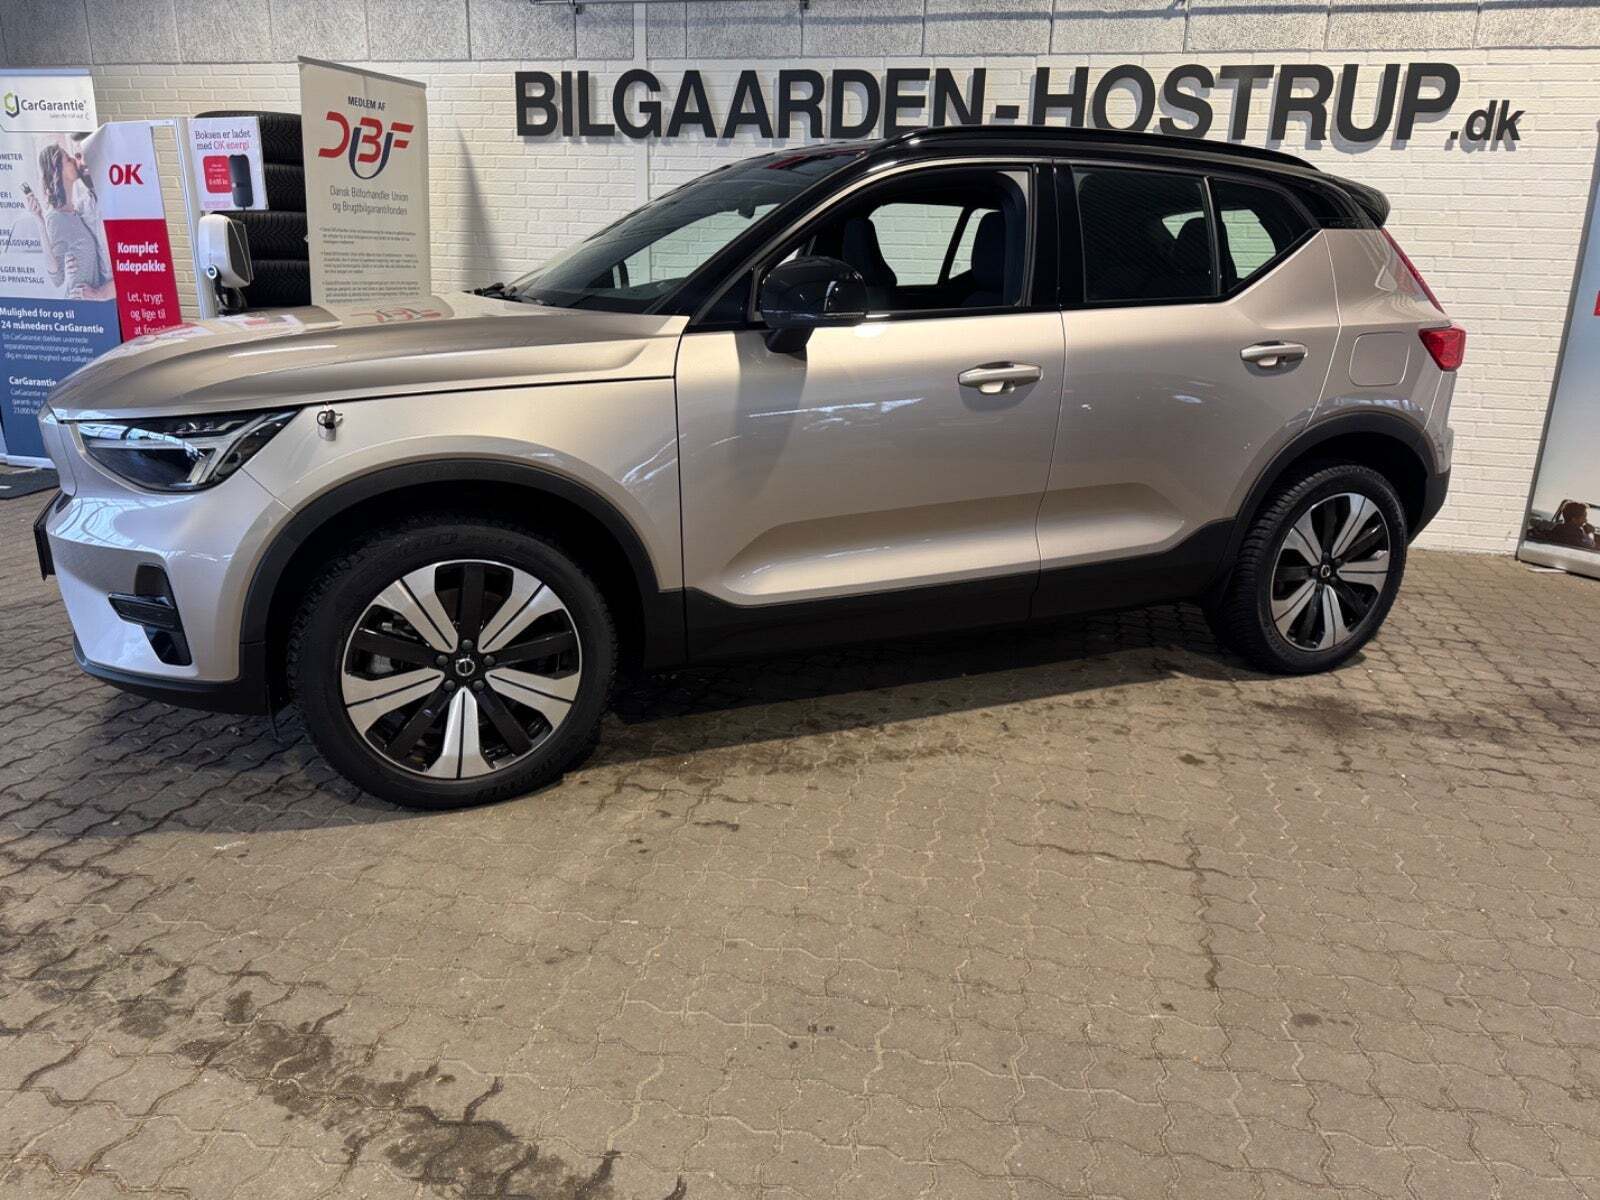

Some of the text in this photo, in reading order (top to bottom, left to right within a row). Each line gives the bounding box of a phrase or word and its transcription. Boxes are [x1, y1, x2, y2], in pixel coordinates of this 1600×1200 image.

[347, 96, 386, 111] MEDLEM AF
[223, 130, 230, 139] er
[196, 141, 212, 150] med
[109, 164, 144, 186] OK
[330, 185, 350, 197] Dansk
[117, 241, 159, 257] Komplet
[116, 259, 166, 275] ladepakke
[143, 293, 163, 305] trygt
[0, 307, 75, 320] Mulighed for op til
[130, 308, 167, 322] og lige til
[1, 320, 104, 334] 24 måneders CarGarantie
[9, 375, 56, 387] CarGarantie
